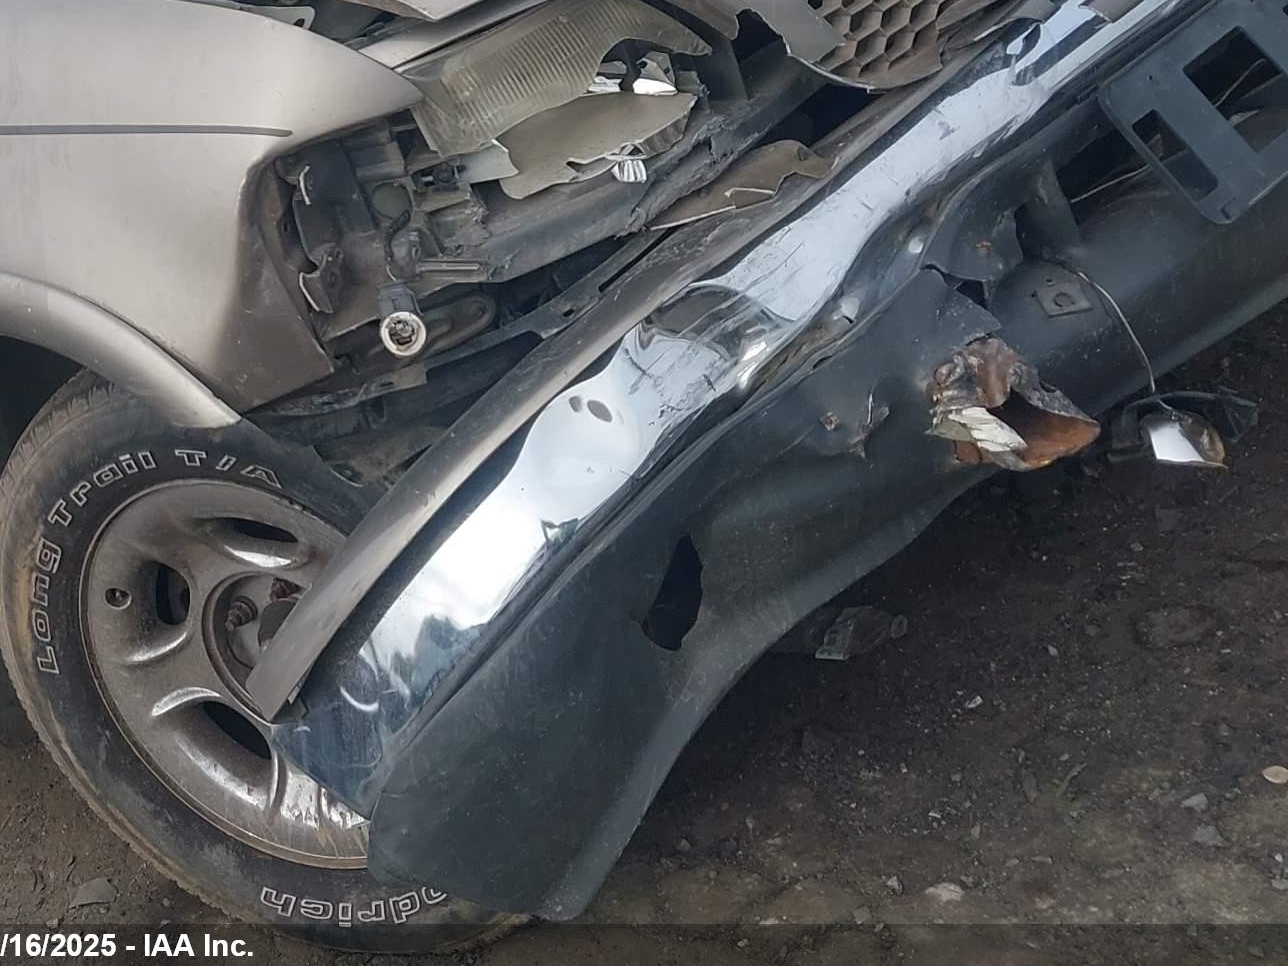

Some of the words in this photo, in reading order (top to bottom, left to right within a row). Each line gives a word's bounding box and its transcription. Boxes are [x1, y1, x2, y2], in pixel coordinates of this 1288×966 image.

[31, 537, 62, 675] Long
[47, 451, 158, 527] Trail
[174, 448, 283, 490] T/A
